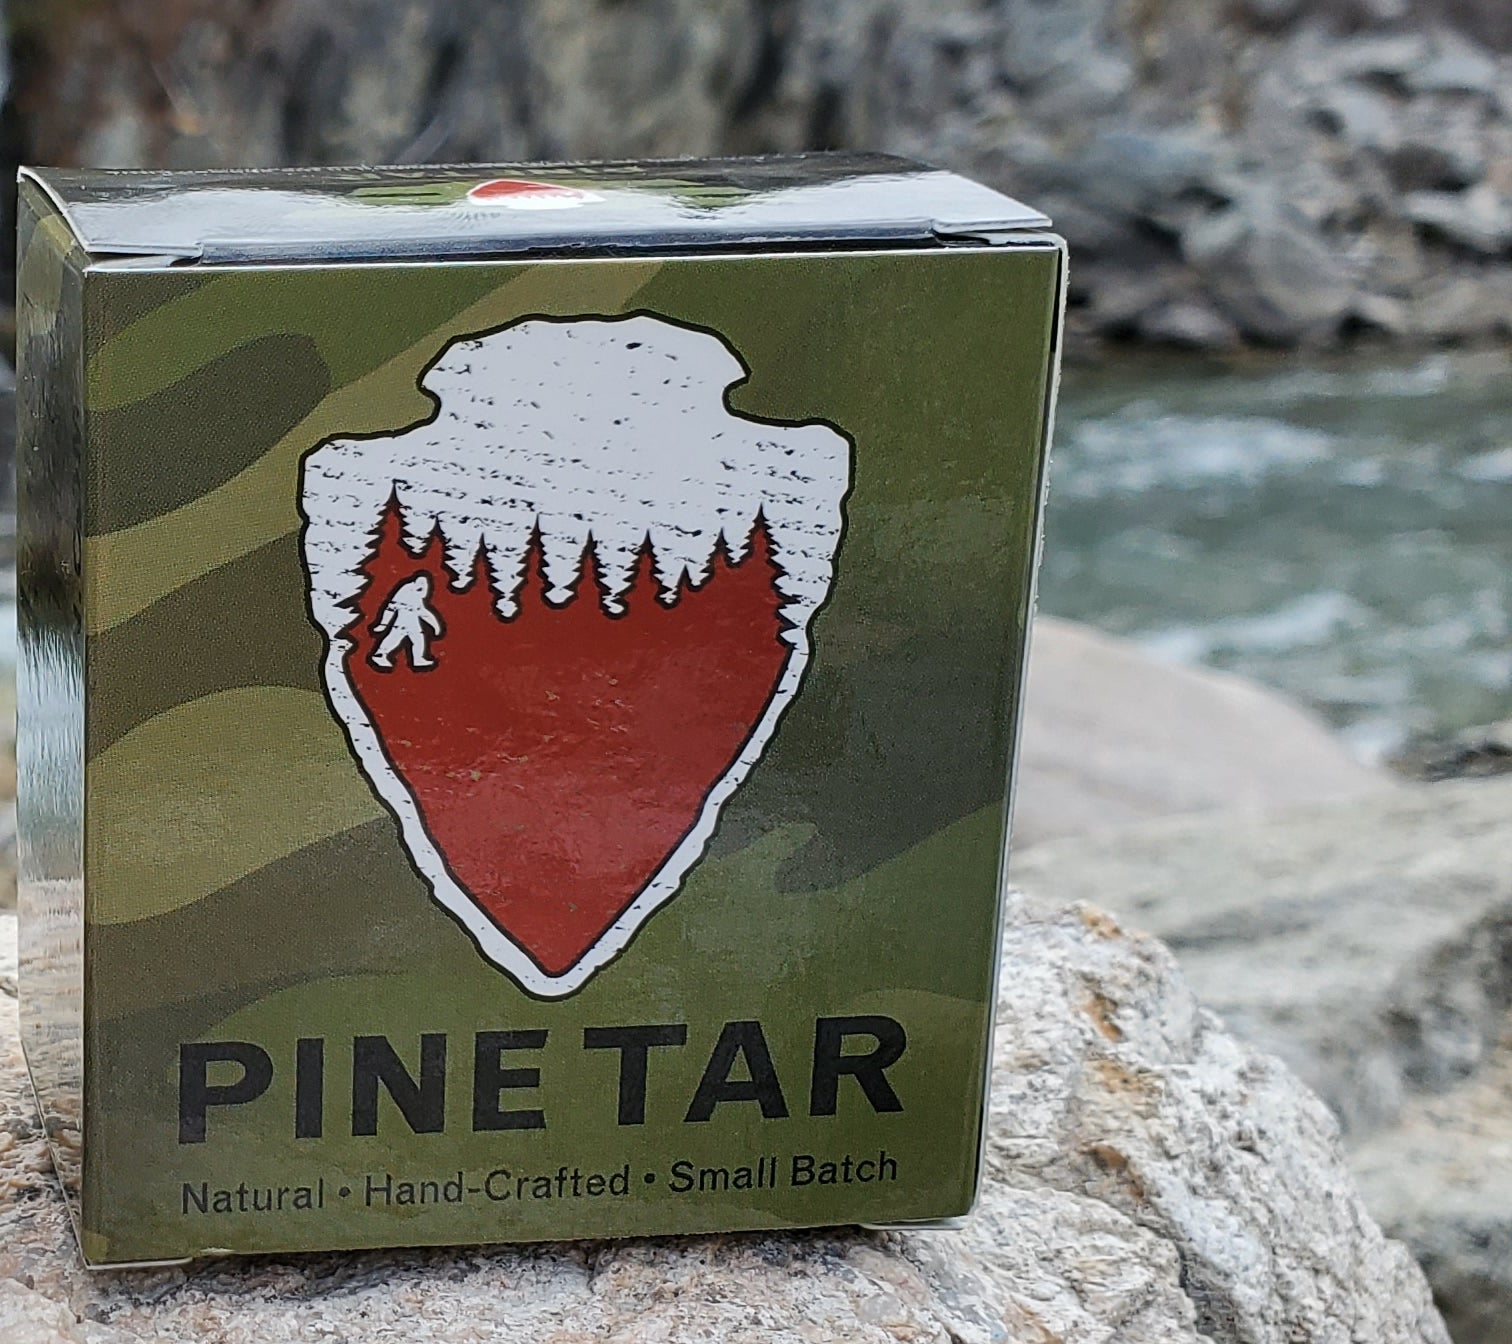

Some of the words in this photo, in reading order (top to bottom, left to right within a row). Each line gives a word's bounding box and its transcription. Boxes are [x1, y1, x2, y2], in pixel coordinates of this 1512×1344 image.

[178, 1028, 549, 1144] PINE
[583, 1015, 907, 1126] TAR
[180, 1177, 324, 1214] Natural
[364, 1164, 630, 1207] Hand-Crafted
[668, 1156, 776, 1193] Small
[790, 1150, 897, 1187] Batch
